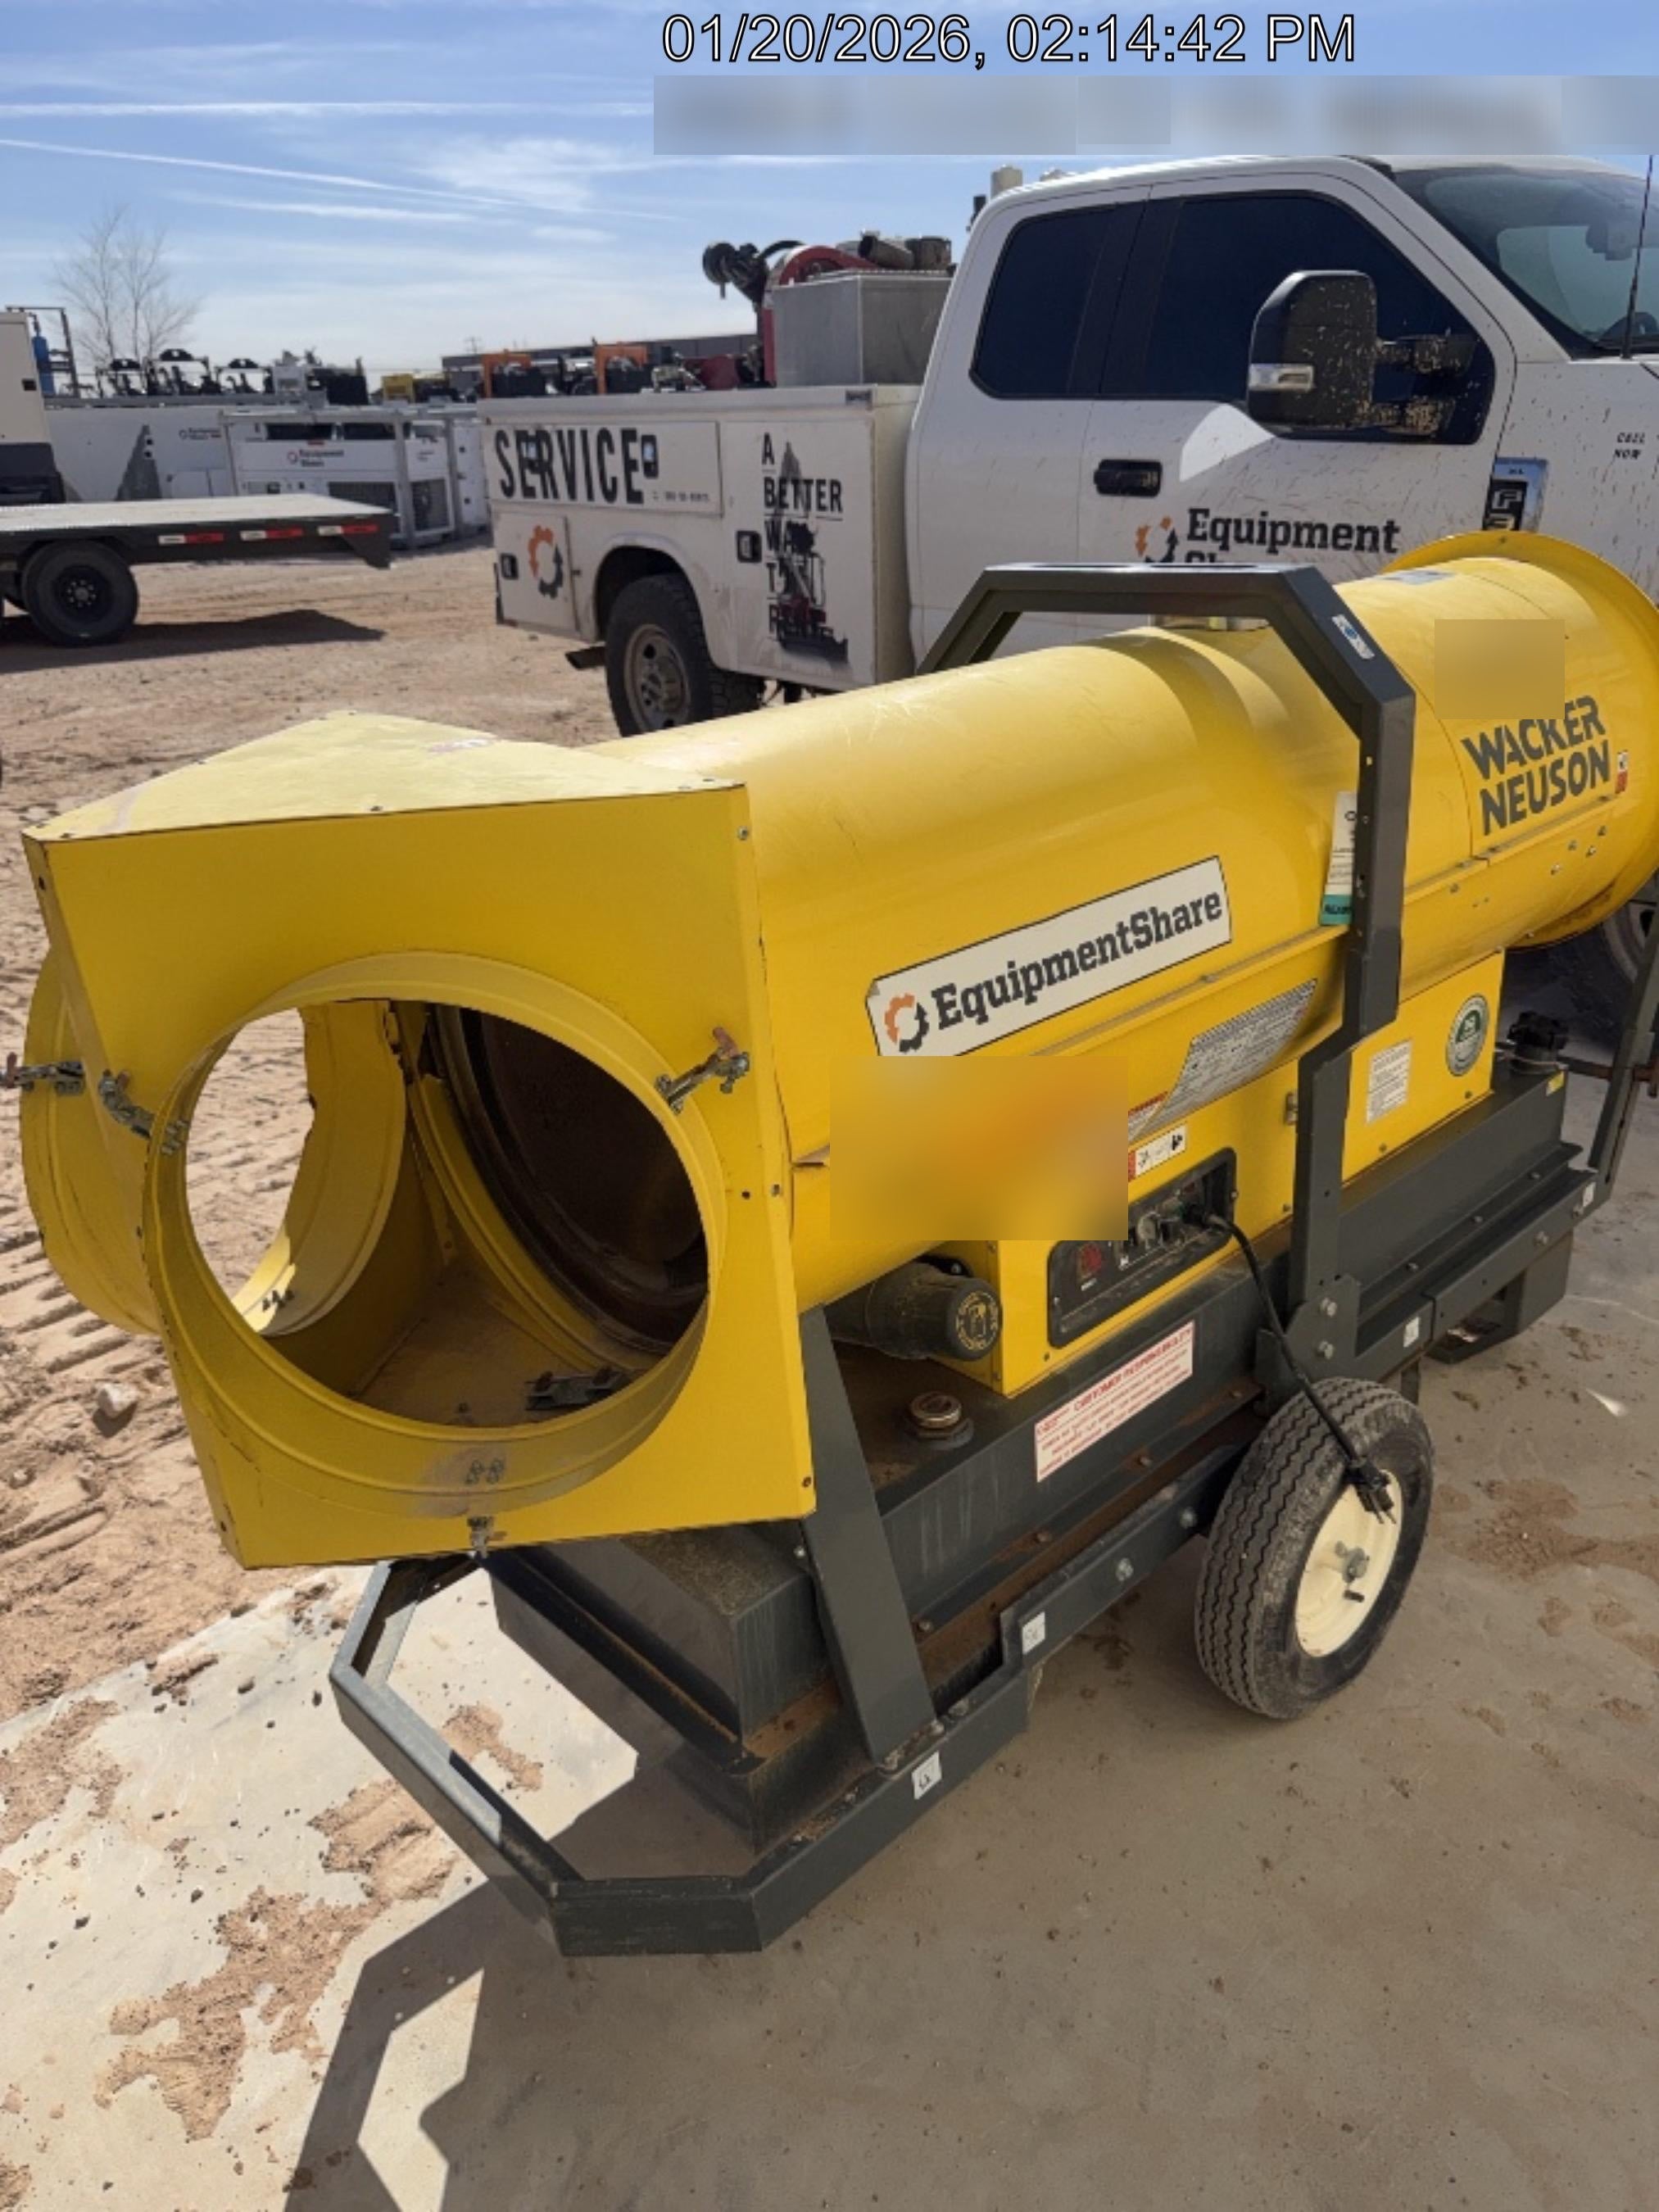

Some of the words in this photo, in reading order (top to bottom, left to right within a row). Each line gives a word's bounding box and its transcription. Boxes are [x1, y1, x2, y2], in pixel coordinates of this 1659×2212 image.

[494, 428, 645, 505] SERVICE
[761, 432, 775, 465] A
[763, 475, 844, 514] BETTER
[1187, 507, 1401, 555] Equipment
[1461, 695, 1606, 780] WACKER
[1479, 739, 1611, 836] NEUSON
[931, 891, 1222, 1030] EquipmentShare
